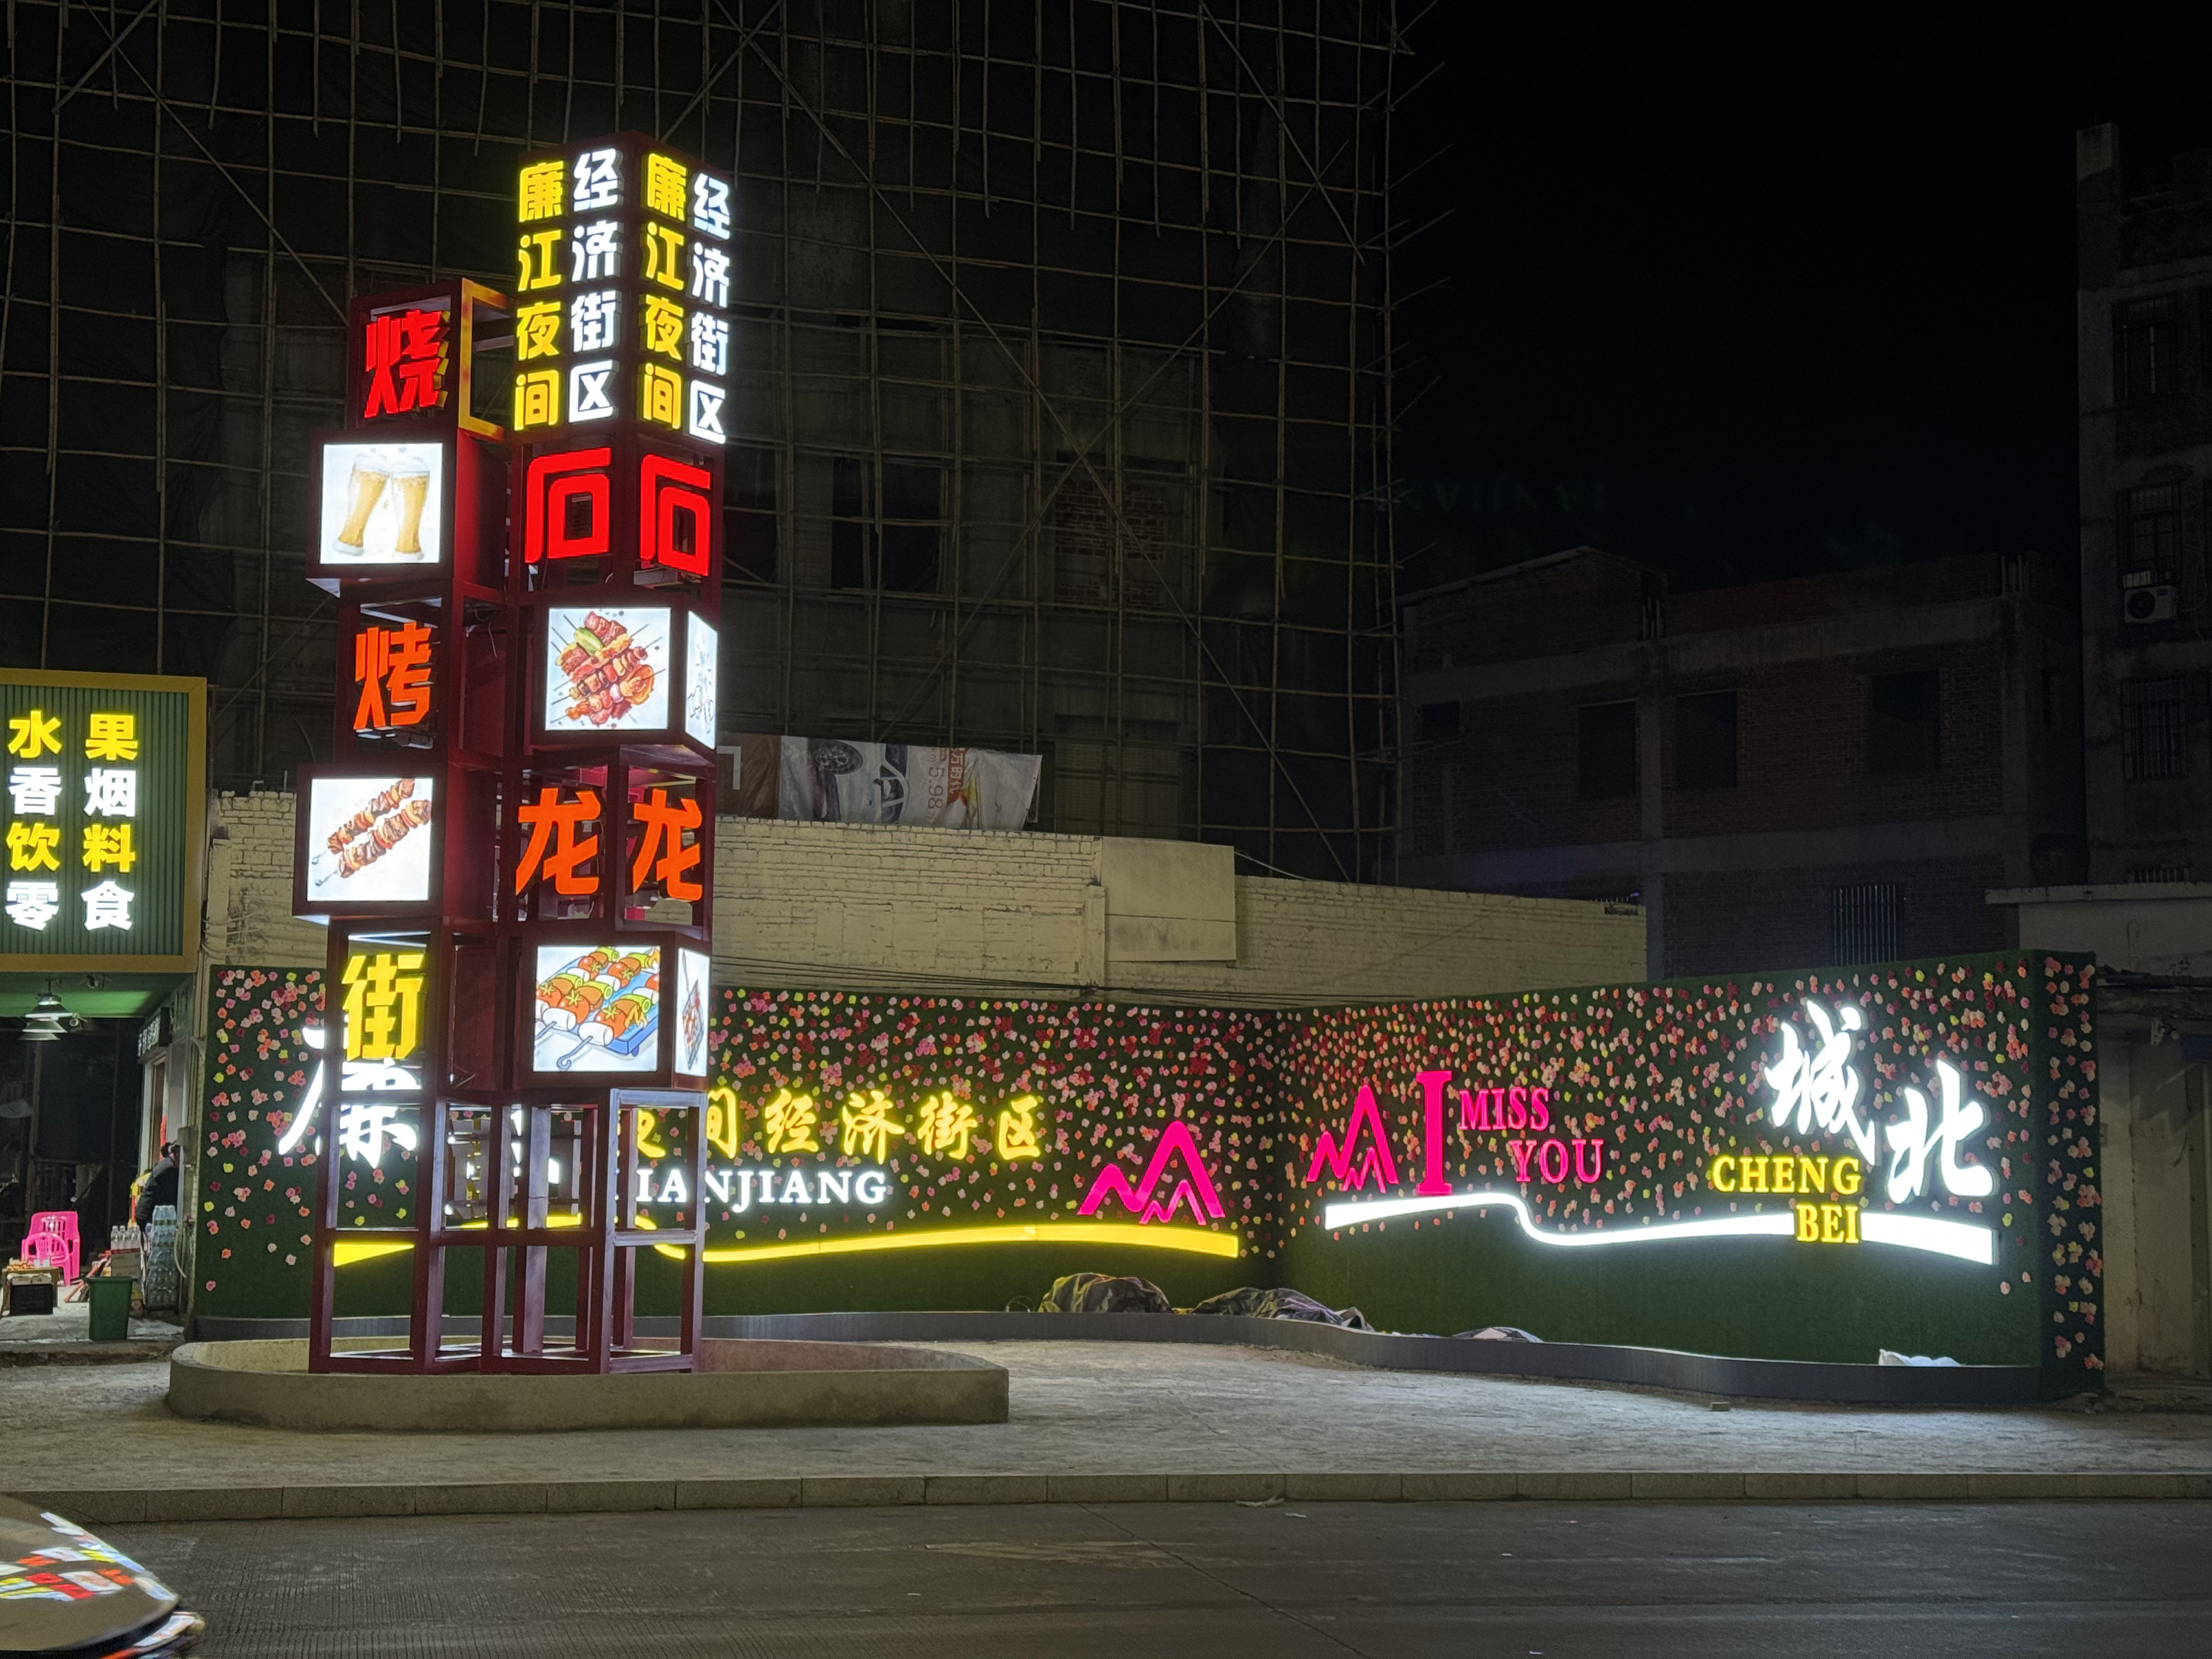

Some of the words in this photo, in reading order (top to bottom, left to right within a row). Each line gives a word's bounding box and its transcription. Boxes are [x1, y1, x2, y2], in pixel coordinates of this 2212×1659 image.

[514, 160, 565, 431] 廉江夜间
[568, 147, 620, 424] 经济街区
[642, 153, 687, 431] 廉江夜间
[689, 172, 731, 445] 经济街区
[8, 710, 138, 761] 水果
[8, 767, 137, 817] 香烟
[6, 822, 136, 873] 饮料
[5, 881, 135, 931] 零食
[1415, 1070, 1452, 1195] I
[1458, 1087, 1549, 1131] MISS
[1509, 1139, 1604, 1183] YOU
[1712, 1155, 1861, 1195] CHENG
[614, 1169, 886, 1213] IANJIANG
[1796, 1203, 1860, 1243] BEI
